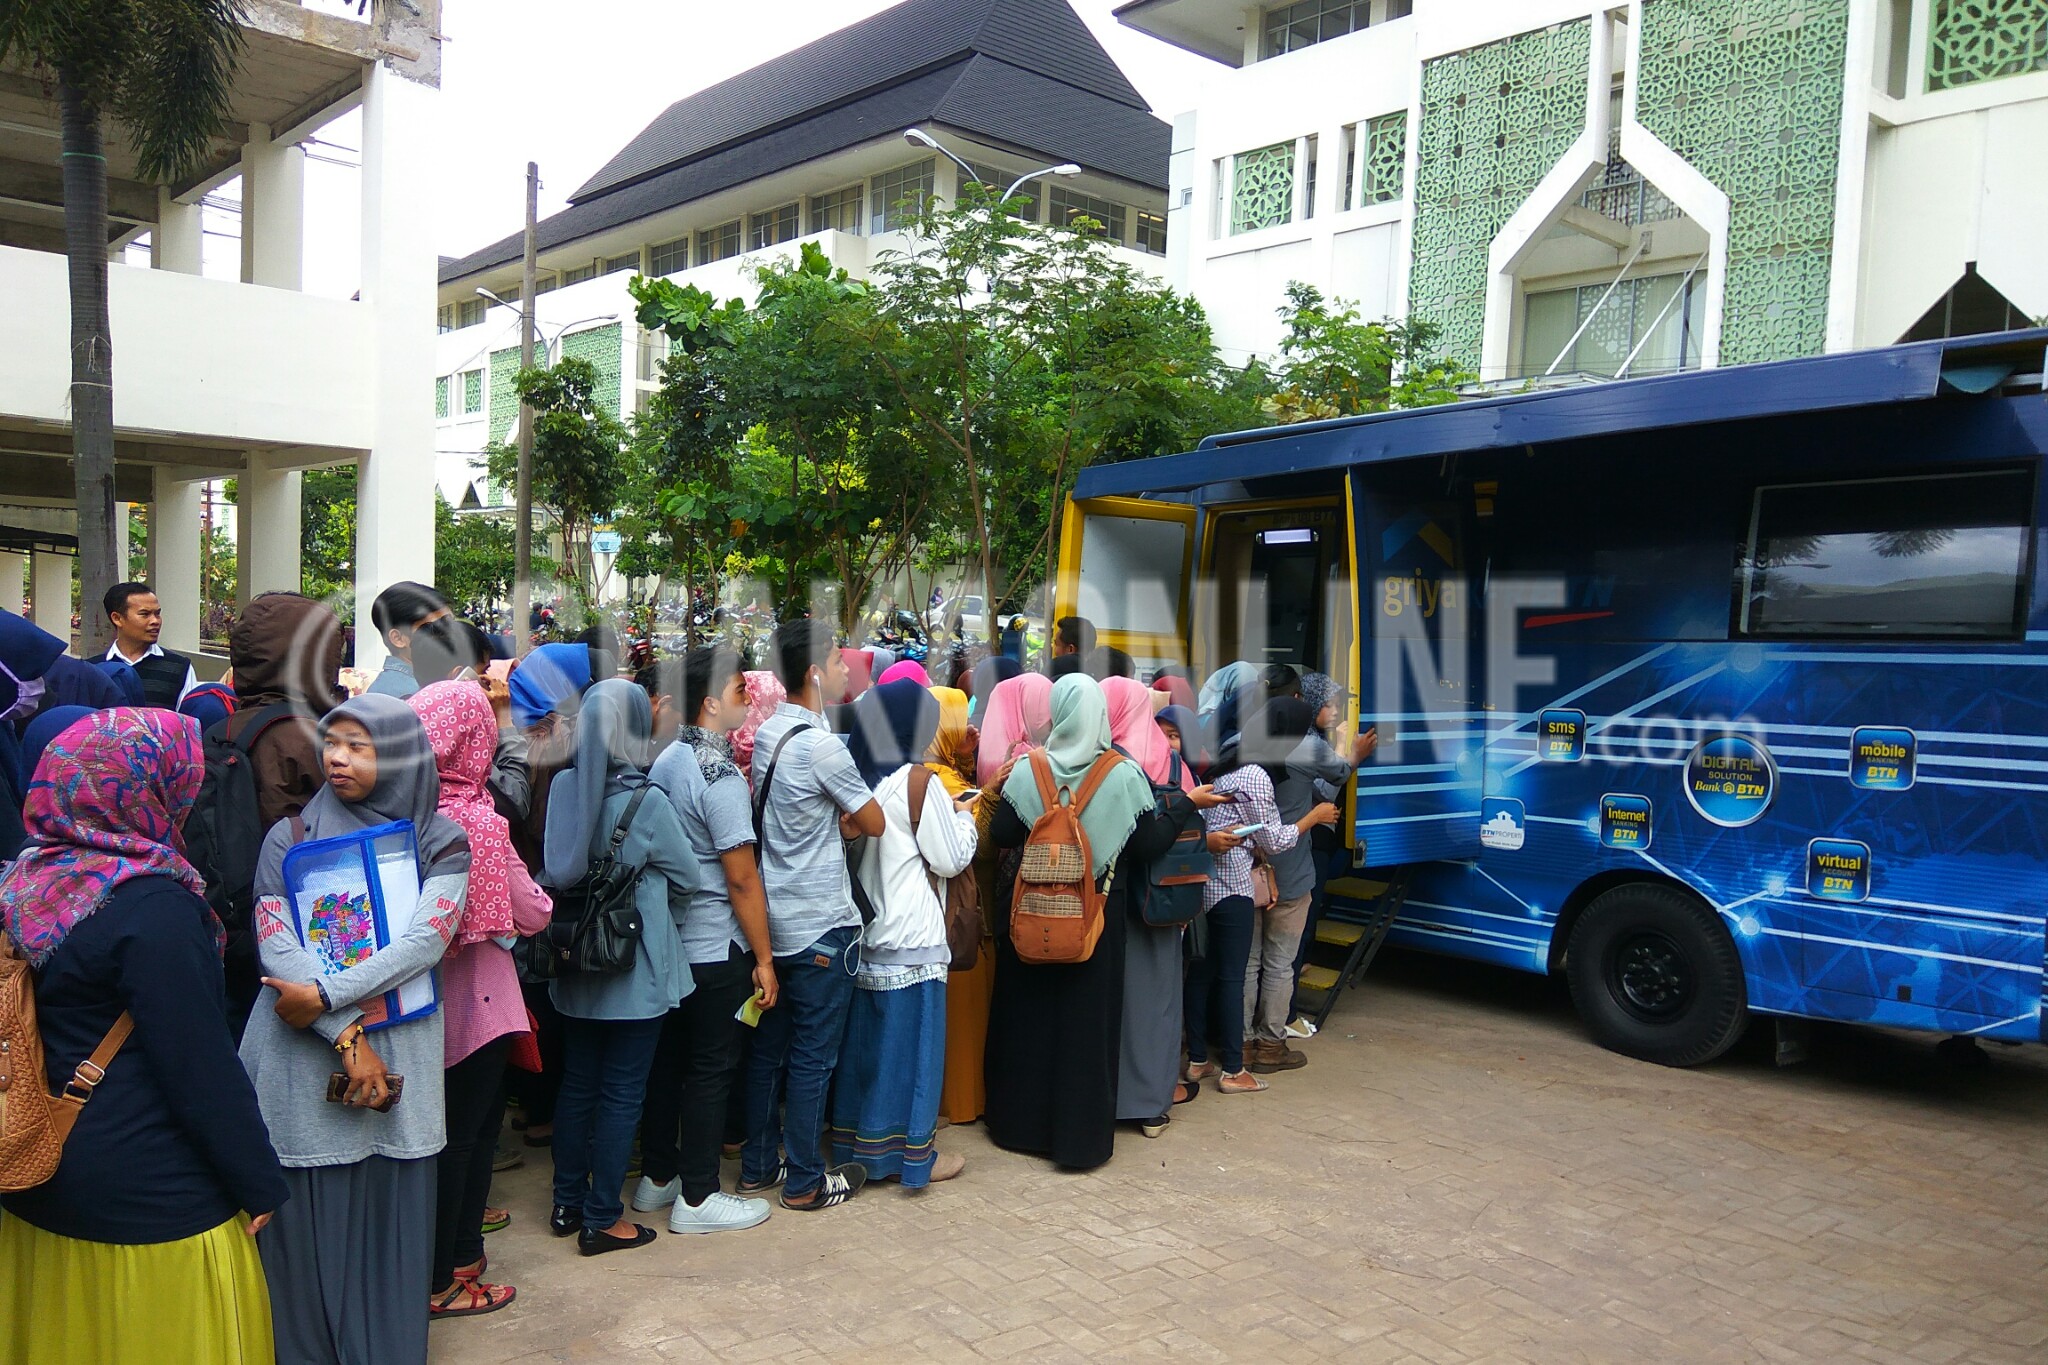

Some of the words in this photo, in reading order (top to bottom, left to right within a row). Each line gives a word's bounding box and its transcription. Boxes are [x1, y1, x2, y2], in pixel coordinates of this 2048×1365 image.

[1384, 567, 1456, 617] griya
[1549, 722, 1576, 734] sms
[1550, 742, 1573, 752] BTN
[1860, 744, 1906, 758] mobile
[1702, 756, 1761, 771] DIGITAL
[1866, 757, 1899, 765] BANKING
[1708, 771, 1753, 781] SOLUTION
[1867, 767, 1899, 778] BTN
[1694, 780, 1721, 793] Bank
[1736, 785, 1765, 796] BTN
[1608, 807, 1647, 822] Internet
[1613, 828, 1638, 840] BTN
[1817, 853, 1861, 870] virtual
[1822, 868, 1857, 878] ACCOUNT
[1824, 876, 1854, 890] BTN
